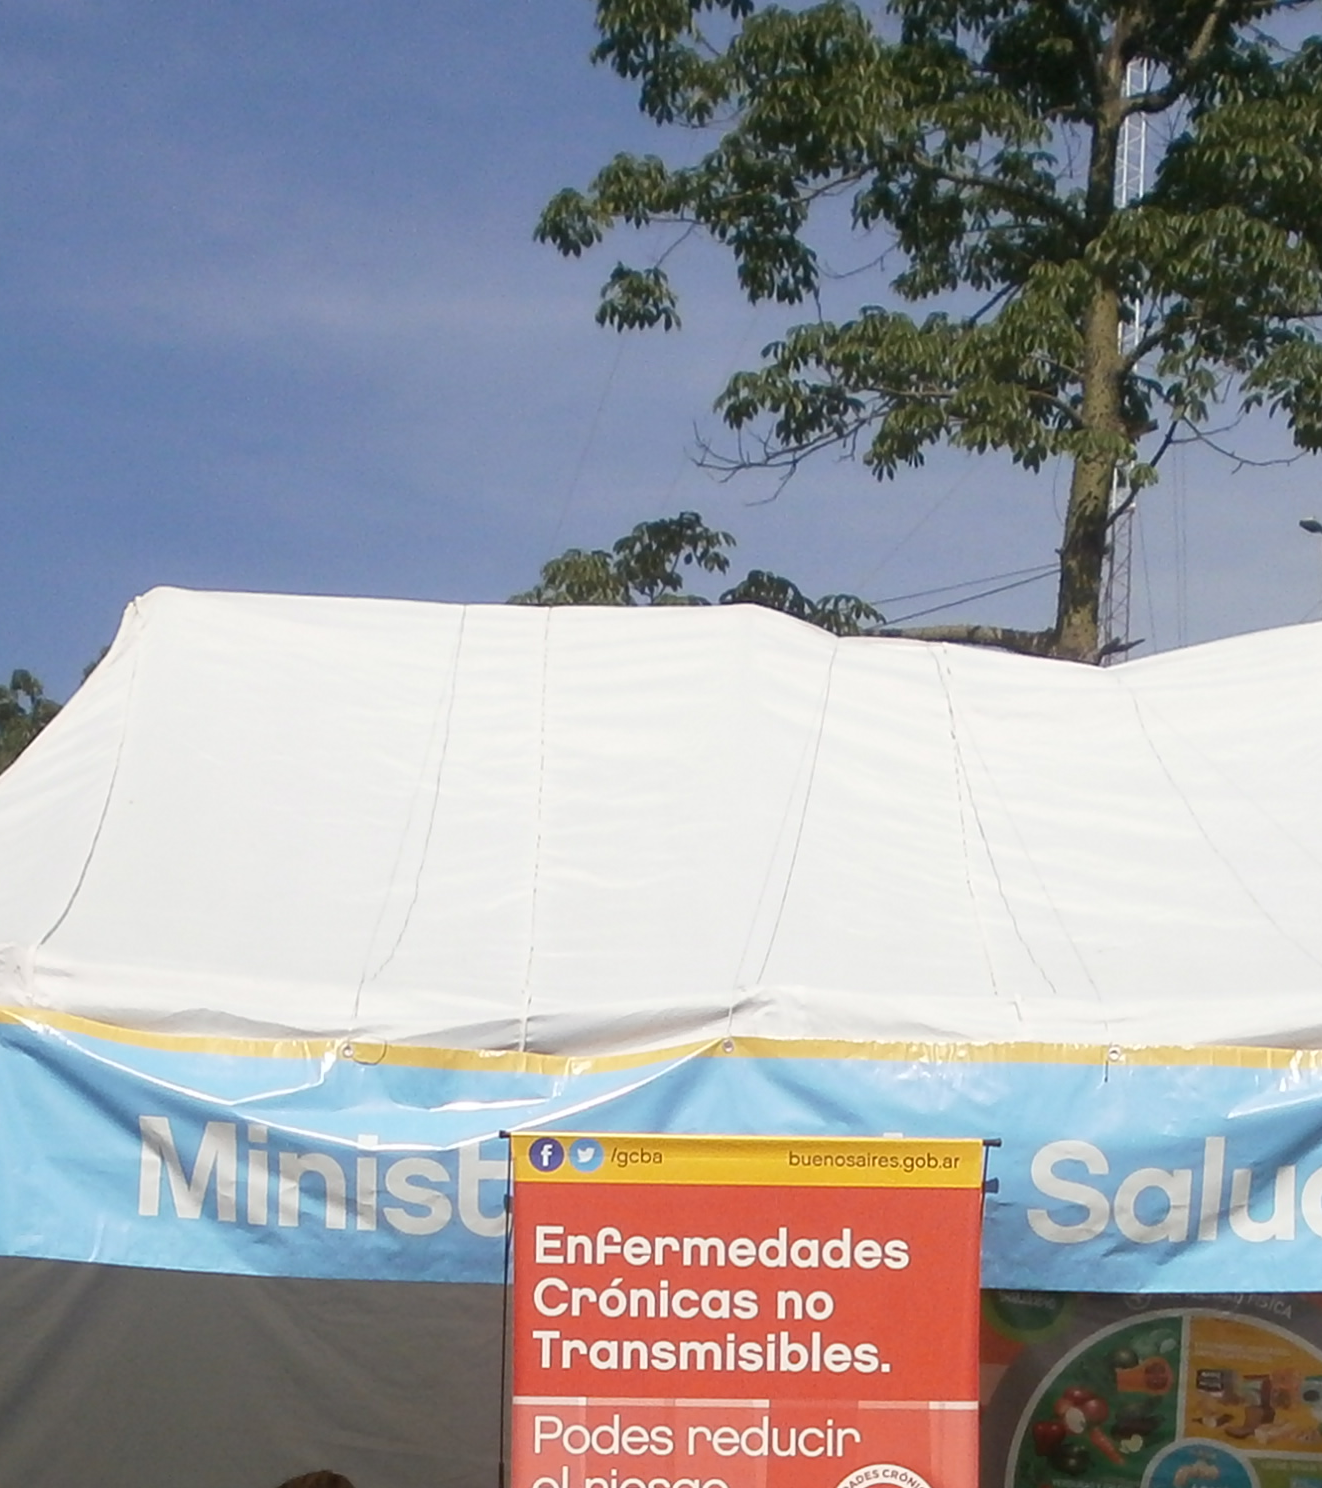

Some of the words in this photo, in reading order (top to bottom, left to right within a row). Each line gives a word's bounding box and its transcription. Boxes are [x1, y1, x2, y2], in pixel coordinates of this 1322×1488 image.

[138, 1115, 513, 1238] Minist
[610, 1149, 663, 1169] /gcba
[788, 1152, 960, 1172] buenosaires.gob.ar
[535, 1225, 910, 1270] Enfermedades
[533, 1277, 759, 1320] Crónicas
[777, 1287, 835, 1320] no
[532, 1330, 891, 1373] Transmisibles.
[533, 1414, 674, 1456] Podes
[687, 1417, 862, 1457] reducir
